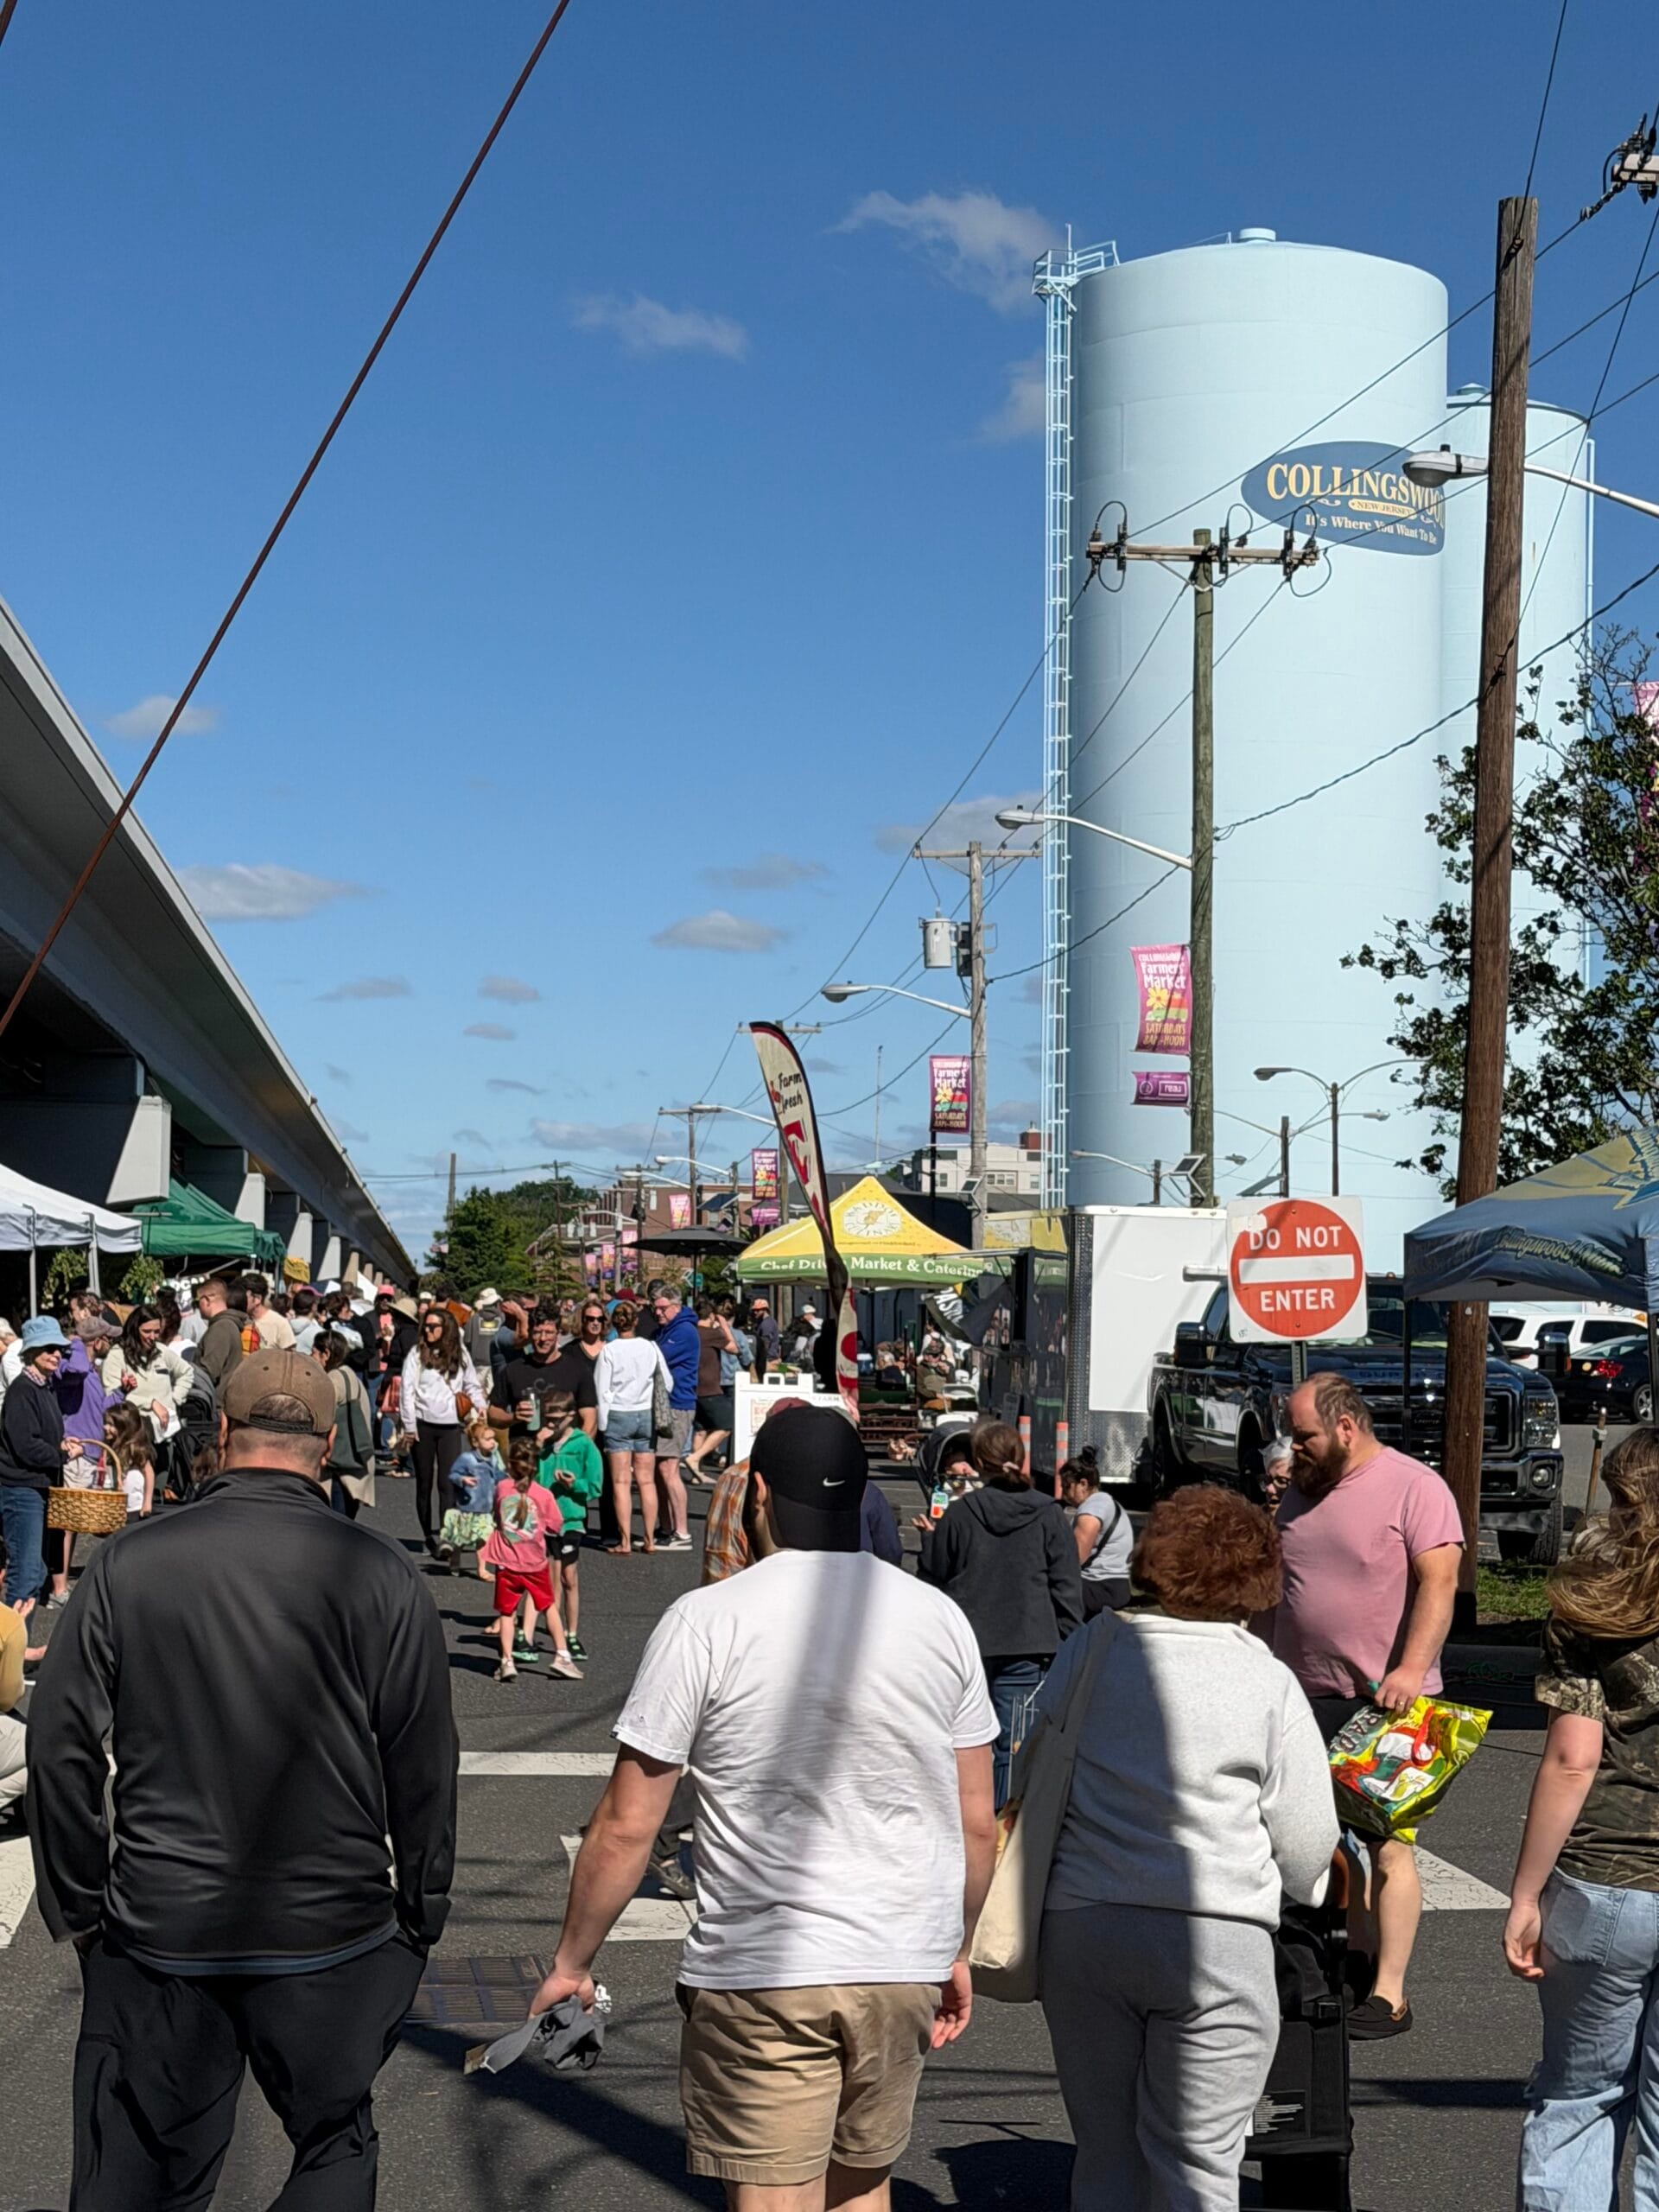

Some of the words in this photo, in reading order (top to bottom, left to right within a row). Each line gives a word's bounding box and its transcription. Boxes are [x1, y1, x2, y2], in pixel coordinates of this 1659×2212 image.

[1357, 502, 1377, 512] NEW
[1382, 504, 1411, 516] JERSEY
[1306, 514, 1327, 526] It's
[1331, 516, 1372, 531] Where
[1375, 520, 1394, 534] You
[1396, 524, 1418, 538] Want
[1419, 529, 1428, 542] To
[1429, 531, 1438, 544] Be
[1143, 974, 1186, 989] Market
[1249, 1229, 1281, 1250] DO
[1296, 1226, 1341, 1248] NOT
[760, 1260, 795, 1270] Chef
[851, 1257, 902, 1271] Market
[907, 1259, 920, 1272] &
[1261, 1288, 1335, 1312] ENTER
